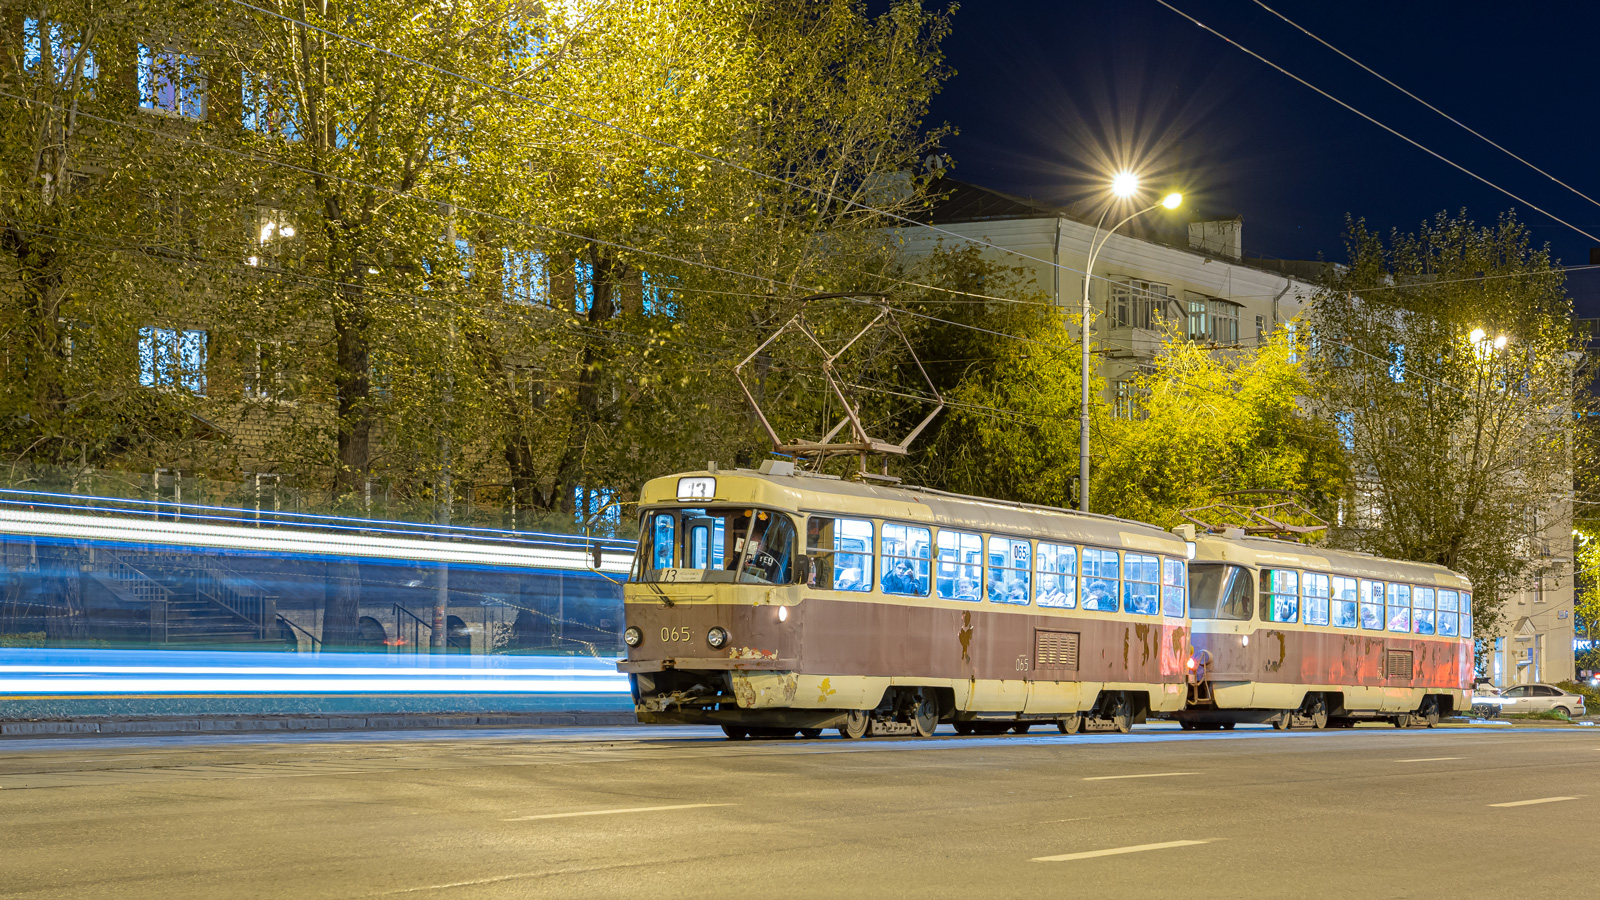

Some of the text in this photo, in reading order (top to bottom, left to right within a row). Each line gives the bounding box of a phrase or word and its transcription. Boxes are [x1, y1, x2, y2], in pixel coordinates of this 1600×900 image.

[688, 482, 706, 501] 13
[1014, 545, 1027, 560] 065
[664, 569, 677, 582] 13
[661, 627, 690, 642] 065
[1016, 658, 1029, 672] 065
